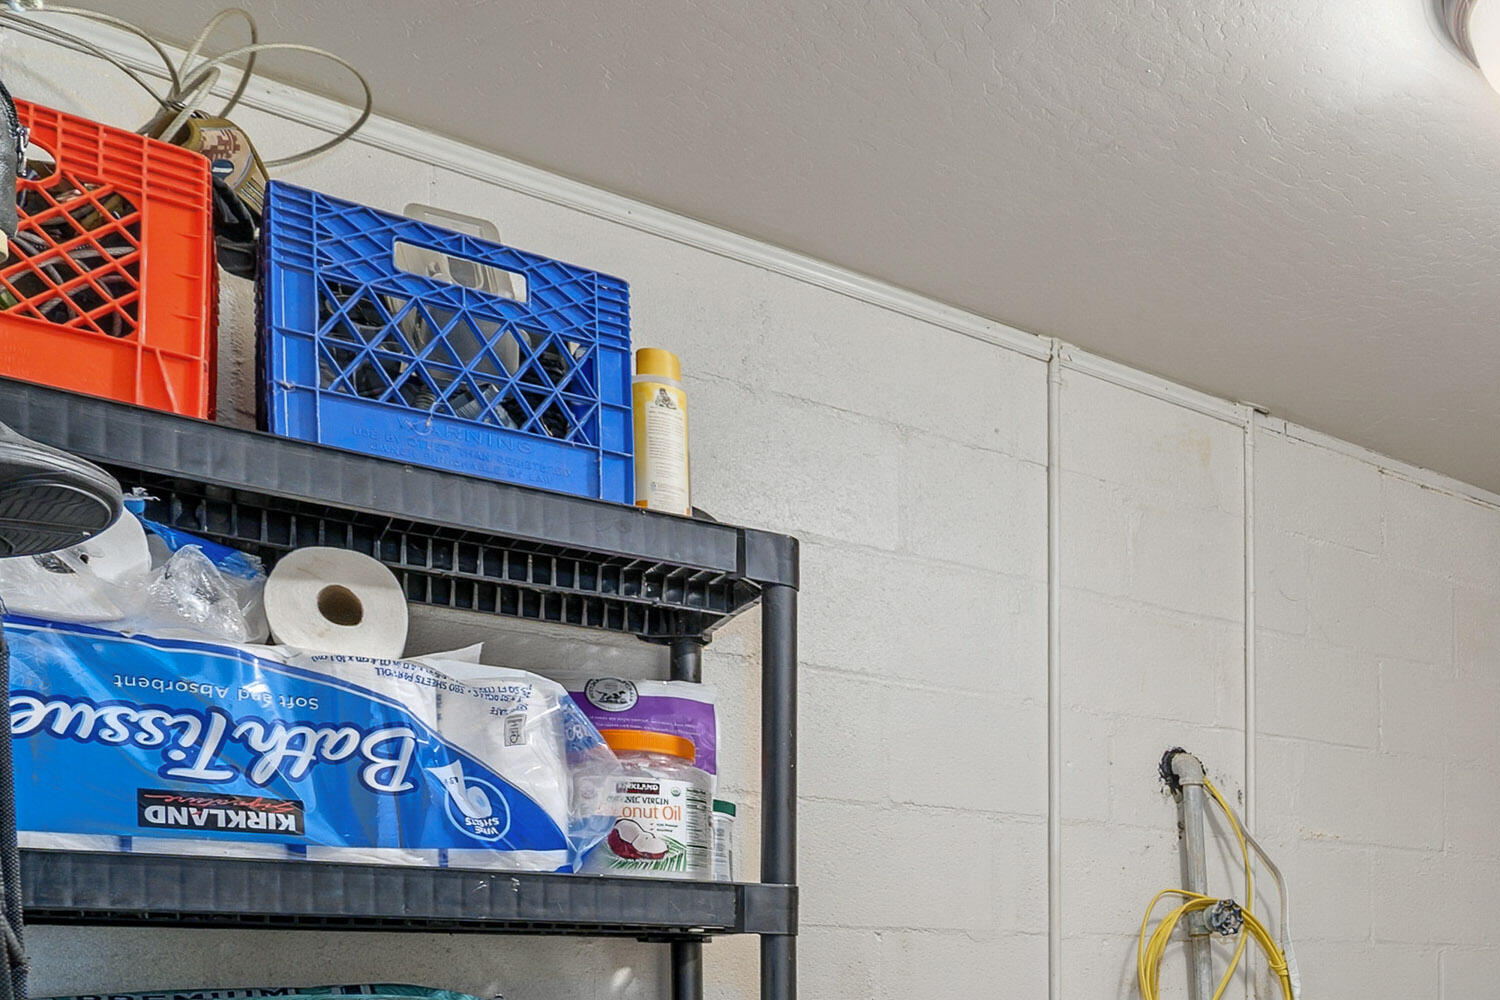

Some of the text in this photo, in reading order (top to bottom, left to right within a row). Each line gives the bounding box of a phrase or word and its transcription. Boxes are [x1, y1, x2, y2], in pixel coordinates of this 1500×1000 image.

[113, 674, 320, 710] Soft and Absorbent
[415, 675, 448, 692] SHEETS
[9, 694, 236, 782] Tissue
[232, 721, 416, 793] Bath
[616, 782, 659, 792] RKLAND
[143, 793, 295, 813] Signature
[617, 806, 681, 821] onut Oil
[143, 804, 296, 832] KIRKLAND
